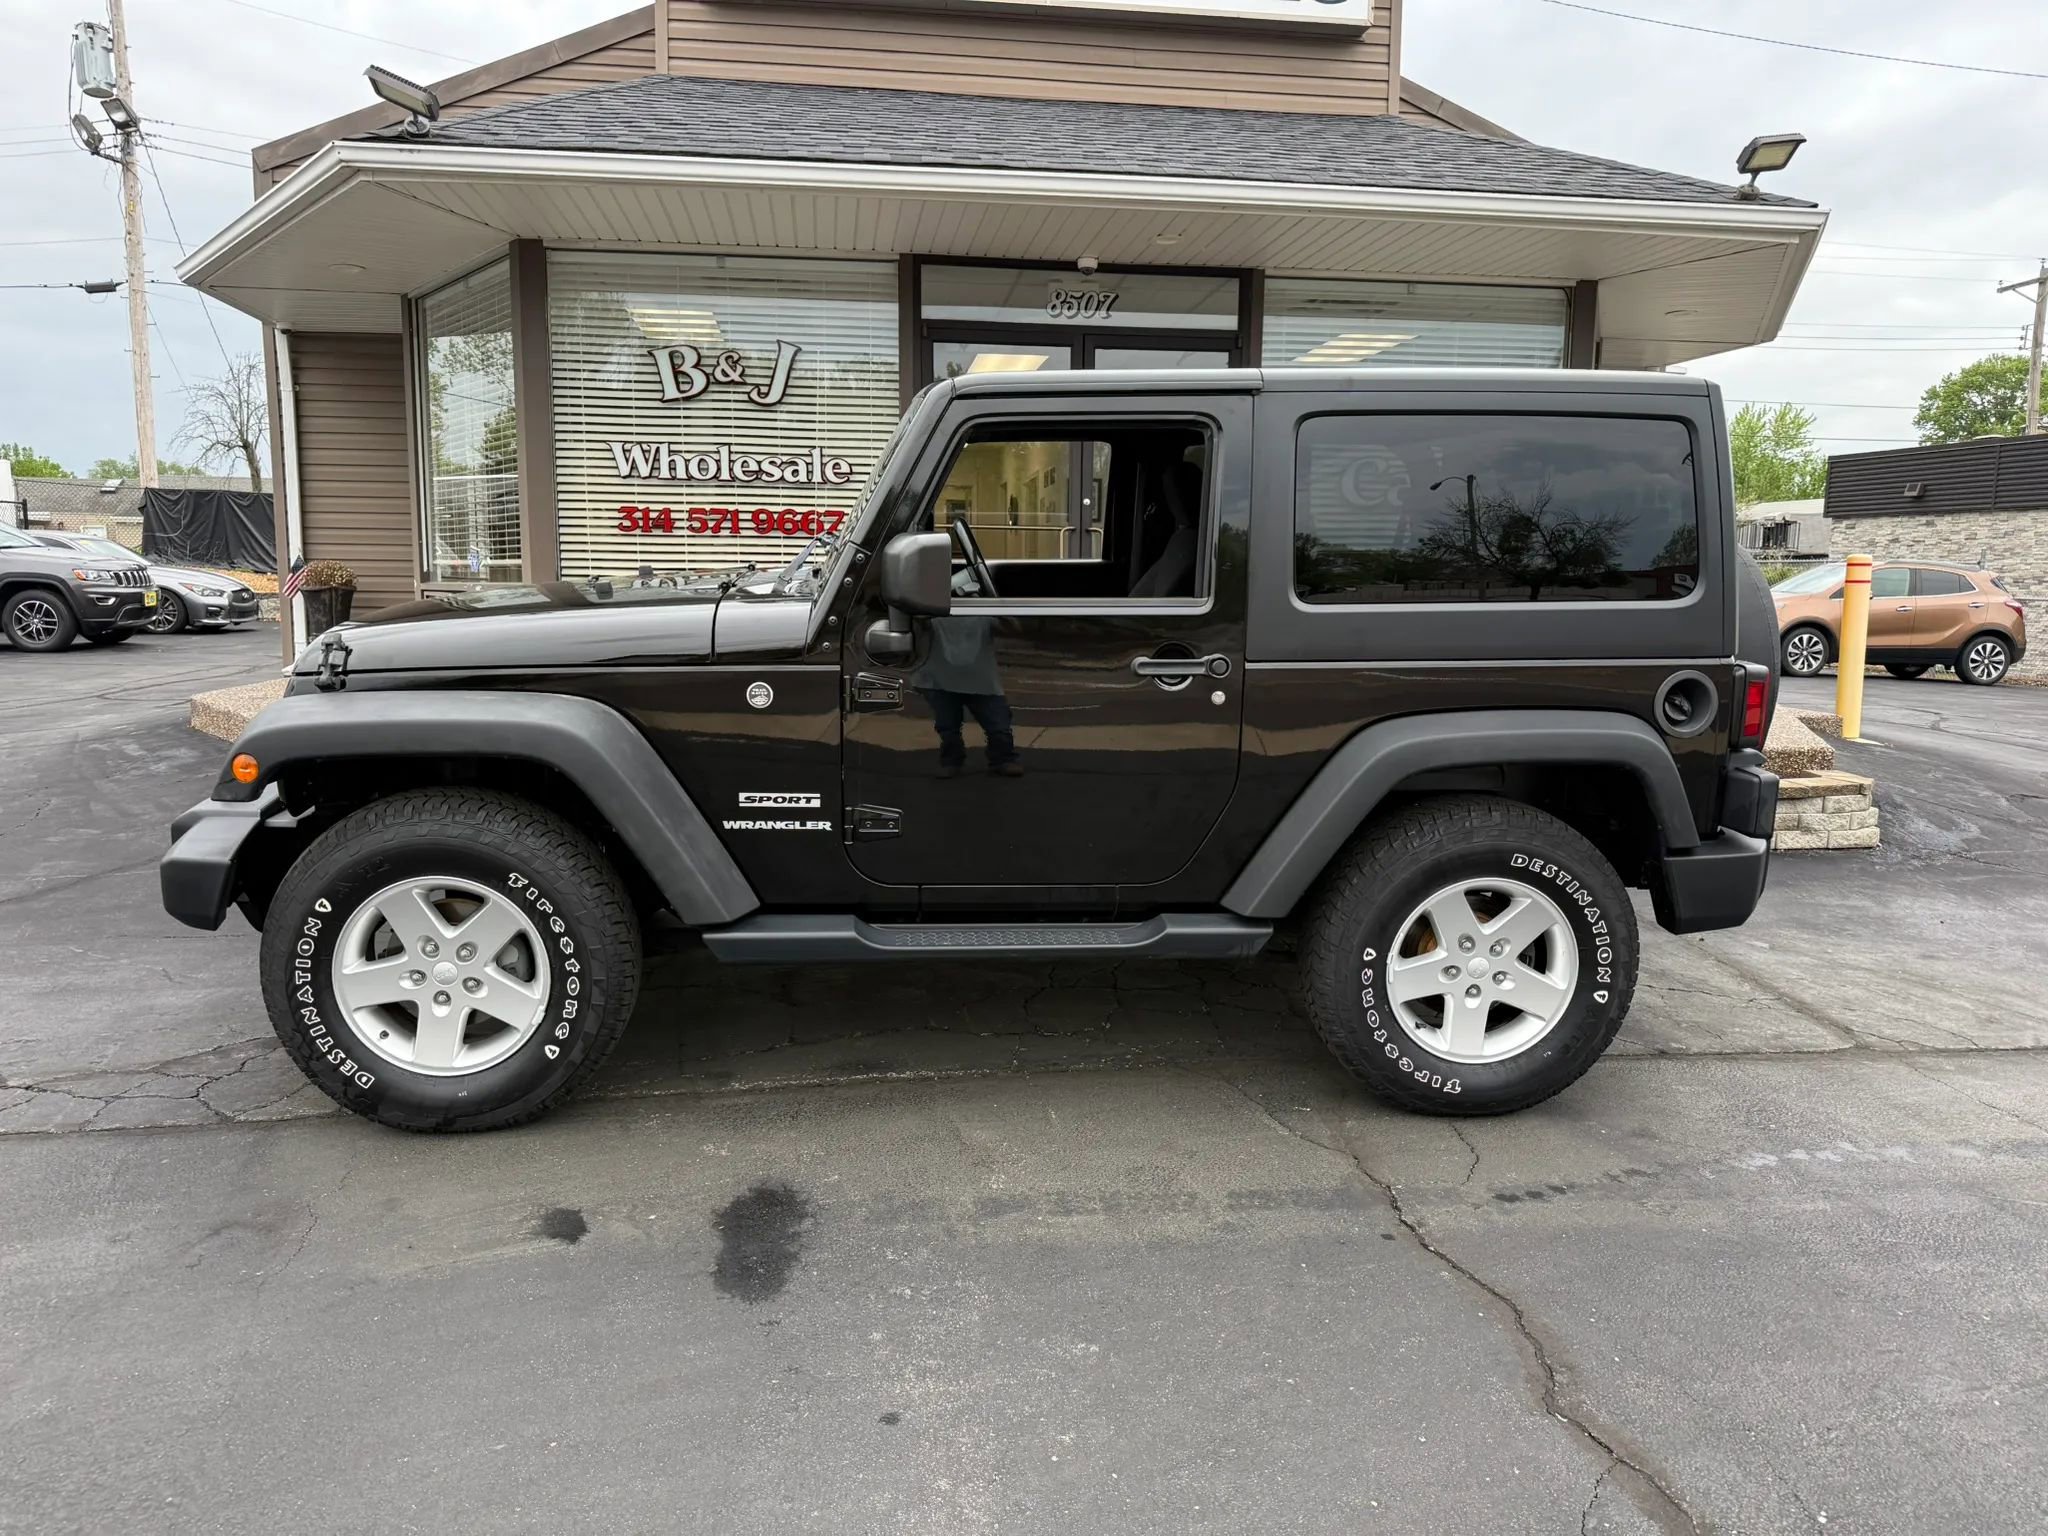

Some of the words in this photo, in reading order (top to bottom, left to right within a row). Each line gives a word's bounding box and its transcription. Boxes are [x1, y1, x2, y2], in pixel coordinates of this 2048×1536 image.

[1046, 288, 1119, 319] 8507
[605, 441, 852, 484] Wholesale
[617, 506, 676, 534] 314
[687, 508, 741, 534] 571
[751, 508, 846, 536] 9667
[741, 793, 820, 806] SPORT
[722, 820, 833, 831] WRANGLER
[1511, 853, 1612, 983] DESTINATION
[295, 917, 375, 1089] DESTINATION
